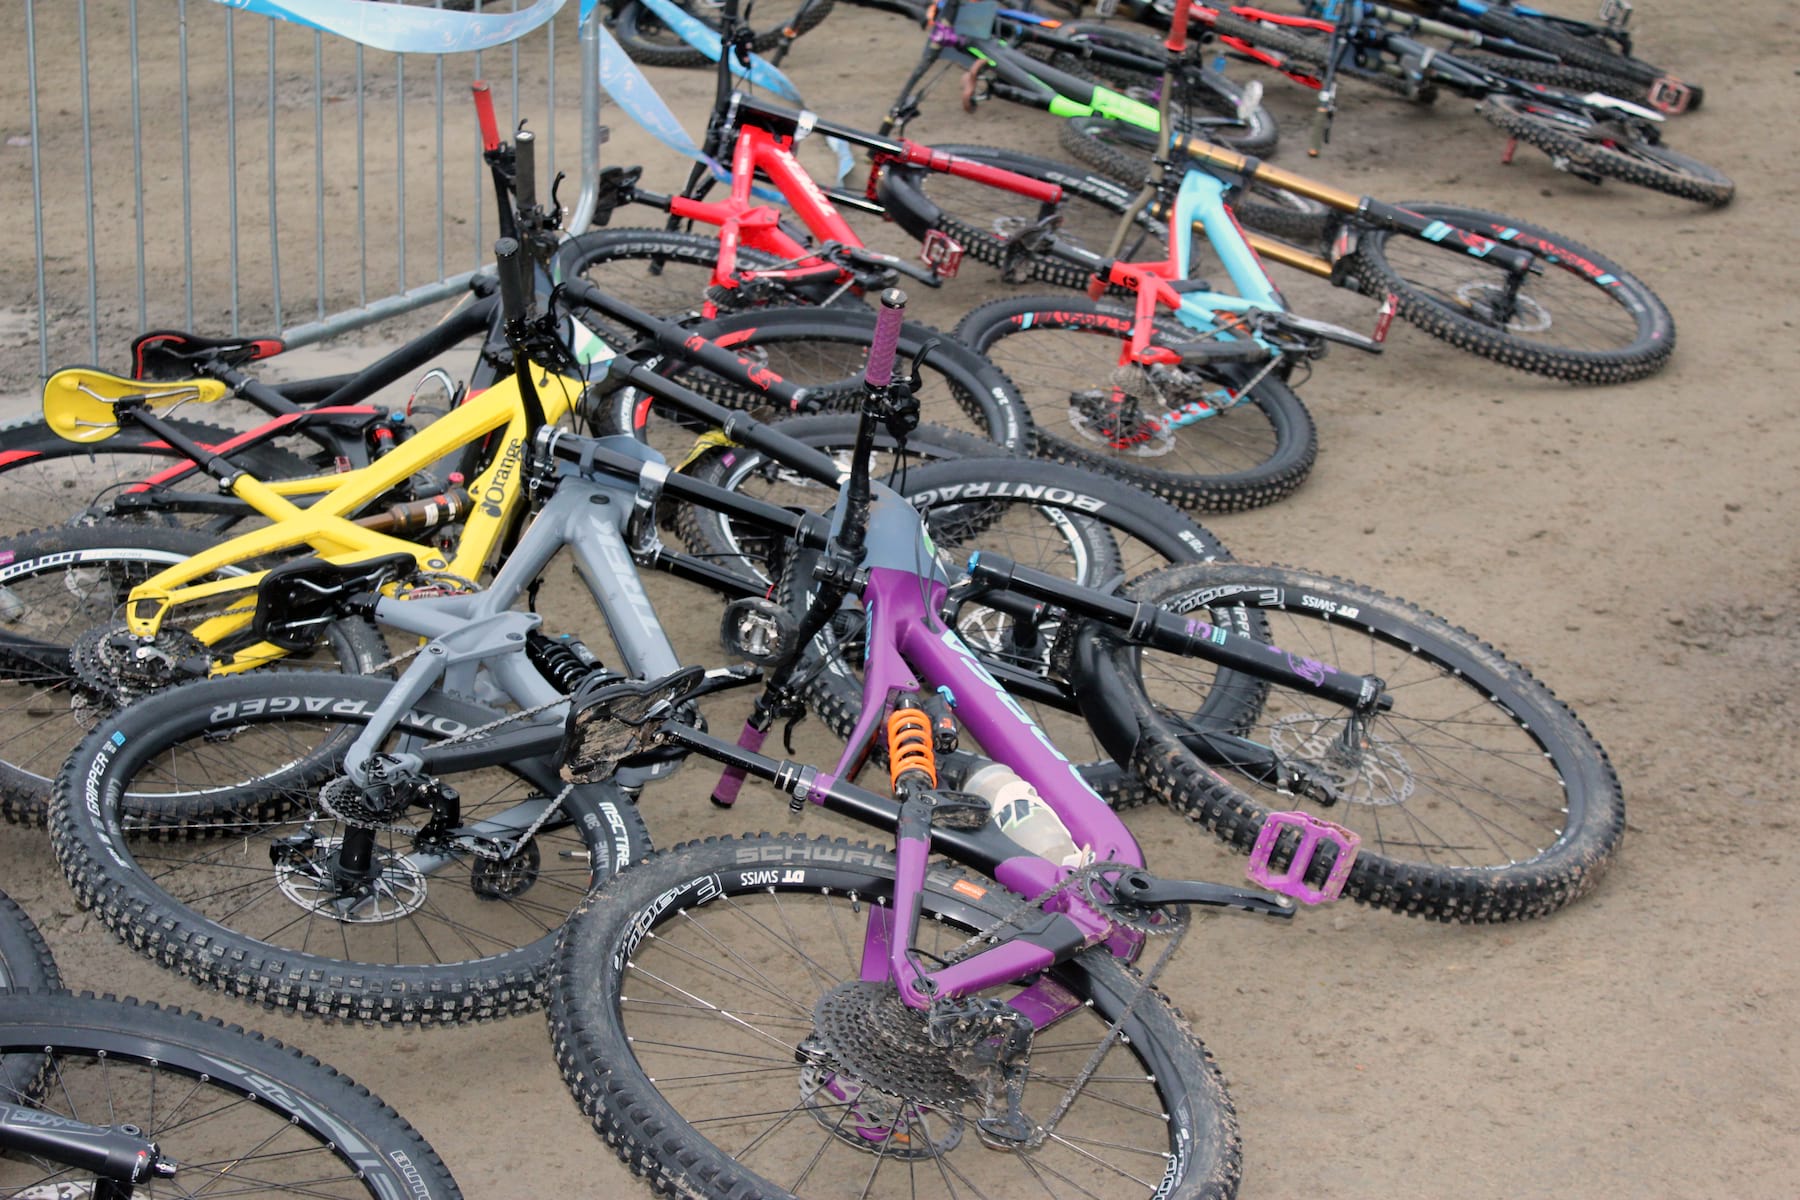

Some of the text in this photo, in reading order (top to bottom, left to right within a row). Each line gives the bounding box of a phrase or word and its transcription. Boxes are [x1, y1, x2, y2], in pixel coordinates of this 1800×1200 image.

[484, 437, 521, 507] Orange
[1232, 606, 1251, 640] IPPE
[1301, 594, 1337, 612] SWISS
[85, 751, 109, 817] GRIPPER
[583, 812, 610, 870] LINE 30
[740, 870, 805, 886] DT SWISS
